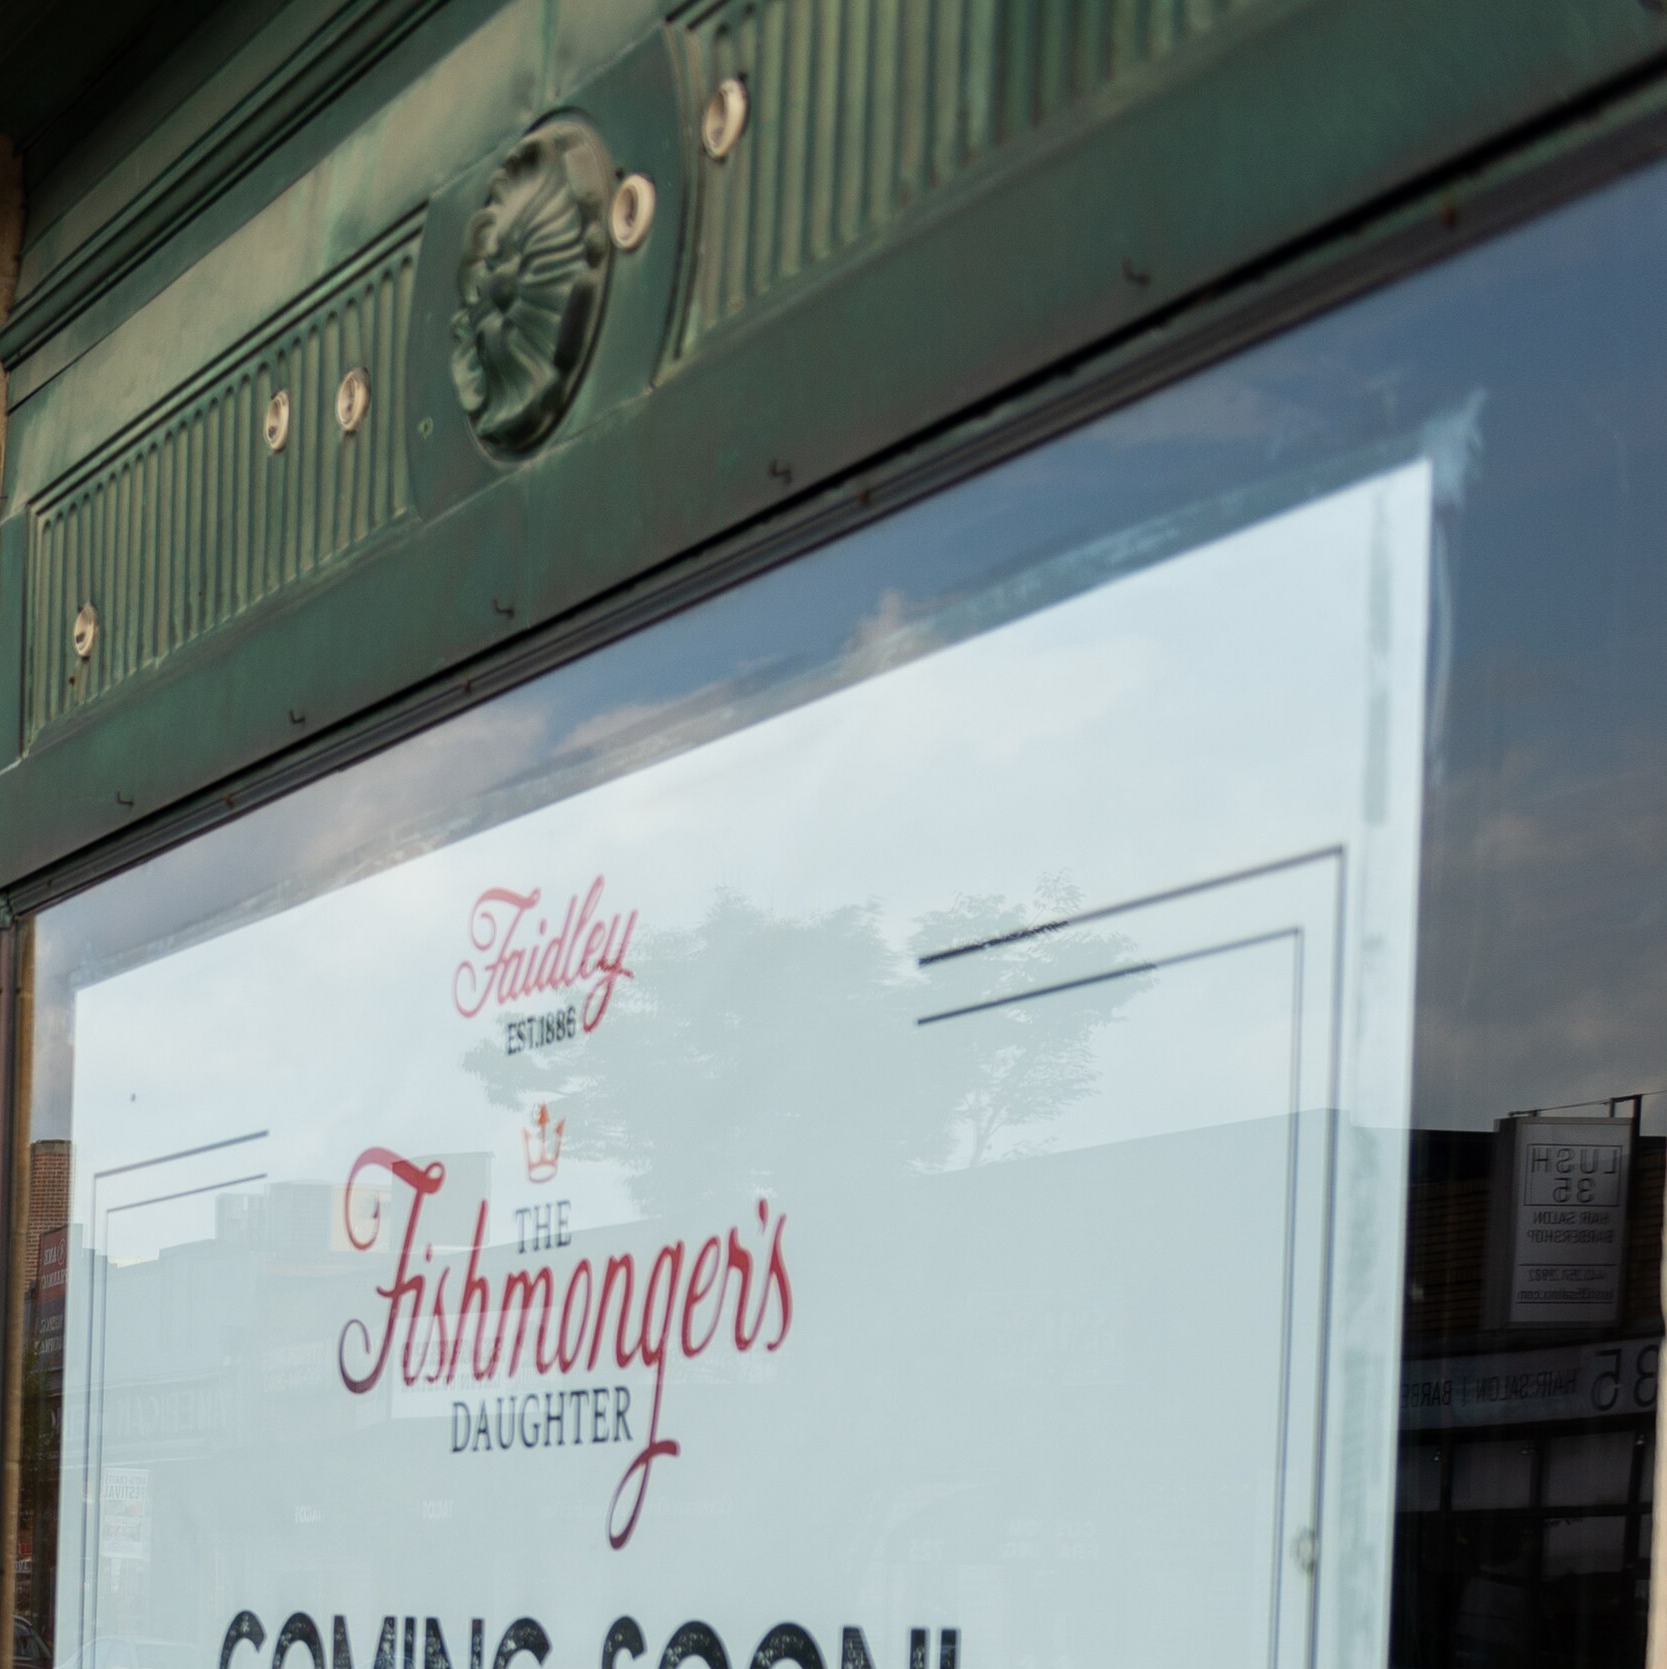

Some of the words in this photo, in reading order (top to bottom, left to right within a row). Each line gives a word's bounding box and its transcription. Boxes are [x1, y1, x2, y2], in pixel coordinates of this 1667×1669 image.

[453, 874, 639, 1033] Faidley
[515, 1200, 573, 1255] THE
[338, 1146, 793, 1550] Fishmonger's
[451, 1386, 634, 1453] DAUGHTER
